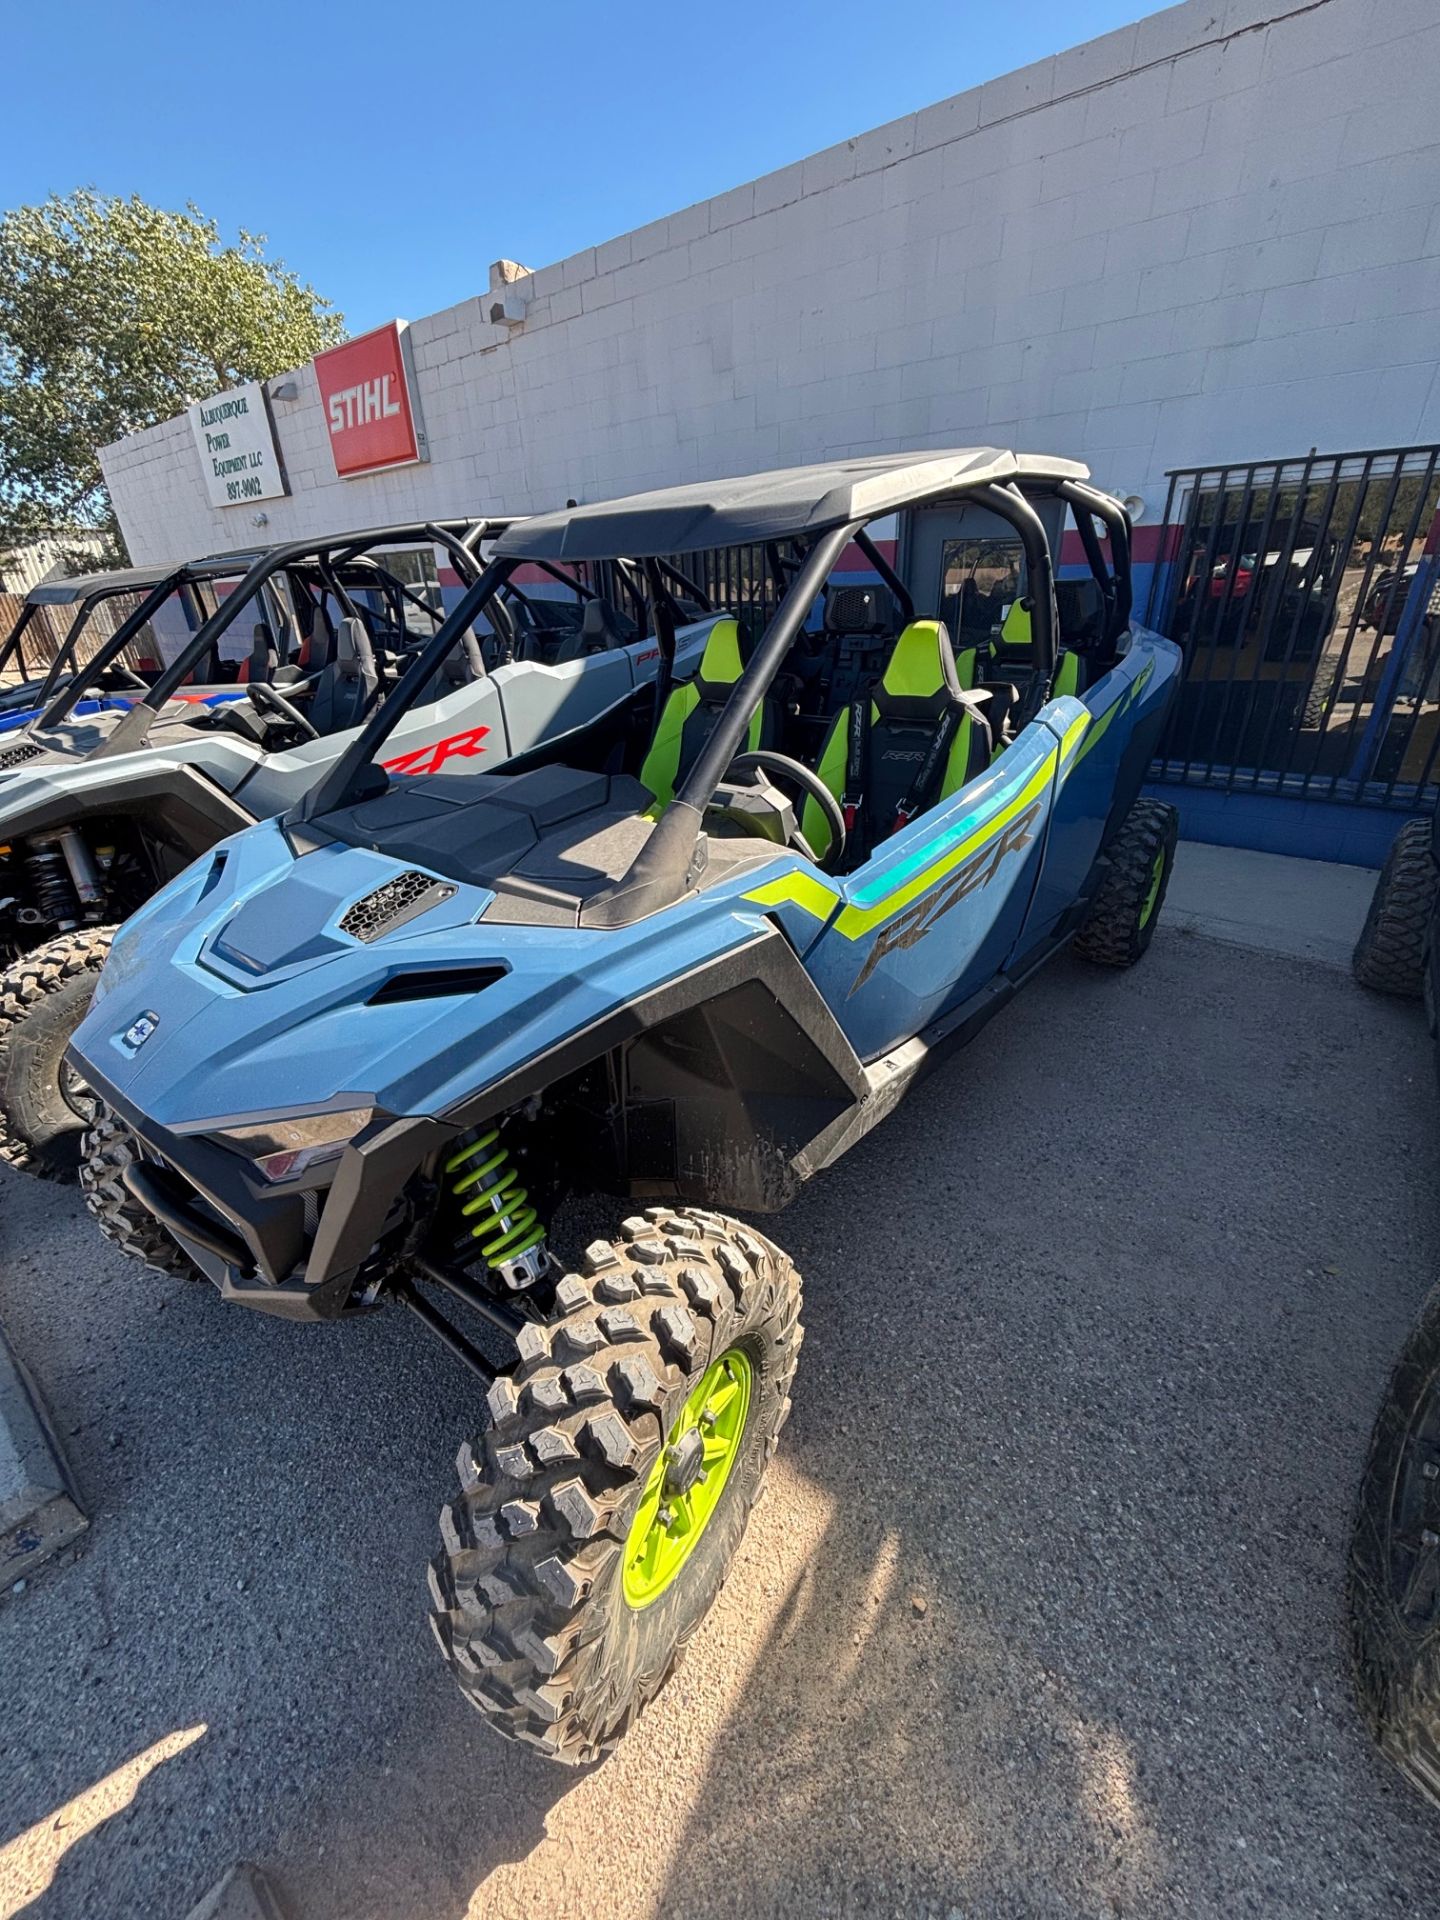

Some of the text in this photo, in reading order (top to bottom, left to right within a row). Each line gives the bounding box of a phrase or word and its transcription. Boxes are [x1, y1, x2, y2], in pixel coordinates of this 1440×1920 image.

[200, 397, 249, 427] ALBUQUERQUE
[329, 374, 400, 434] STIHL
[205, 433, 231, 453] POWER
[212, 451, 263, 478] EQUIPMENT LLC
[227, 477, 262, 500] 897-9002
[881, 750, 926, 761] RZR
[845, 801, 1043, 1001] RZR
